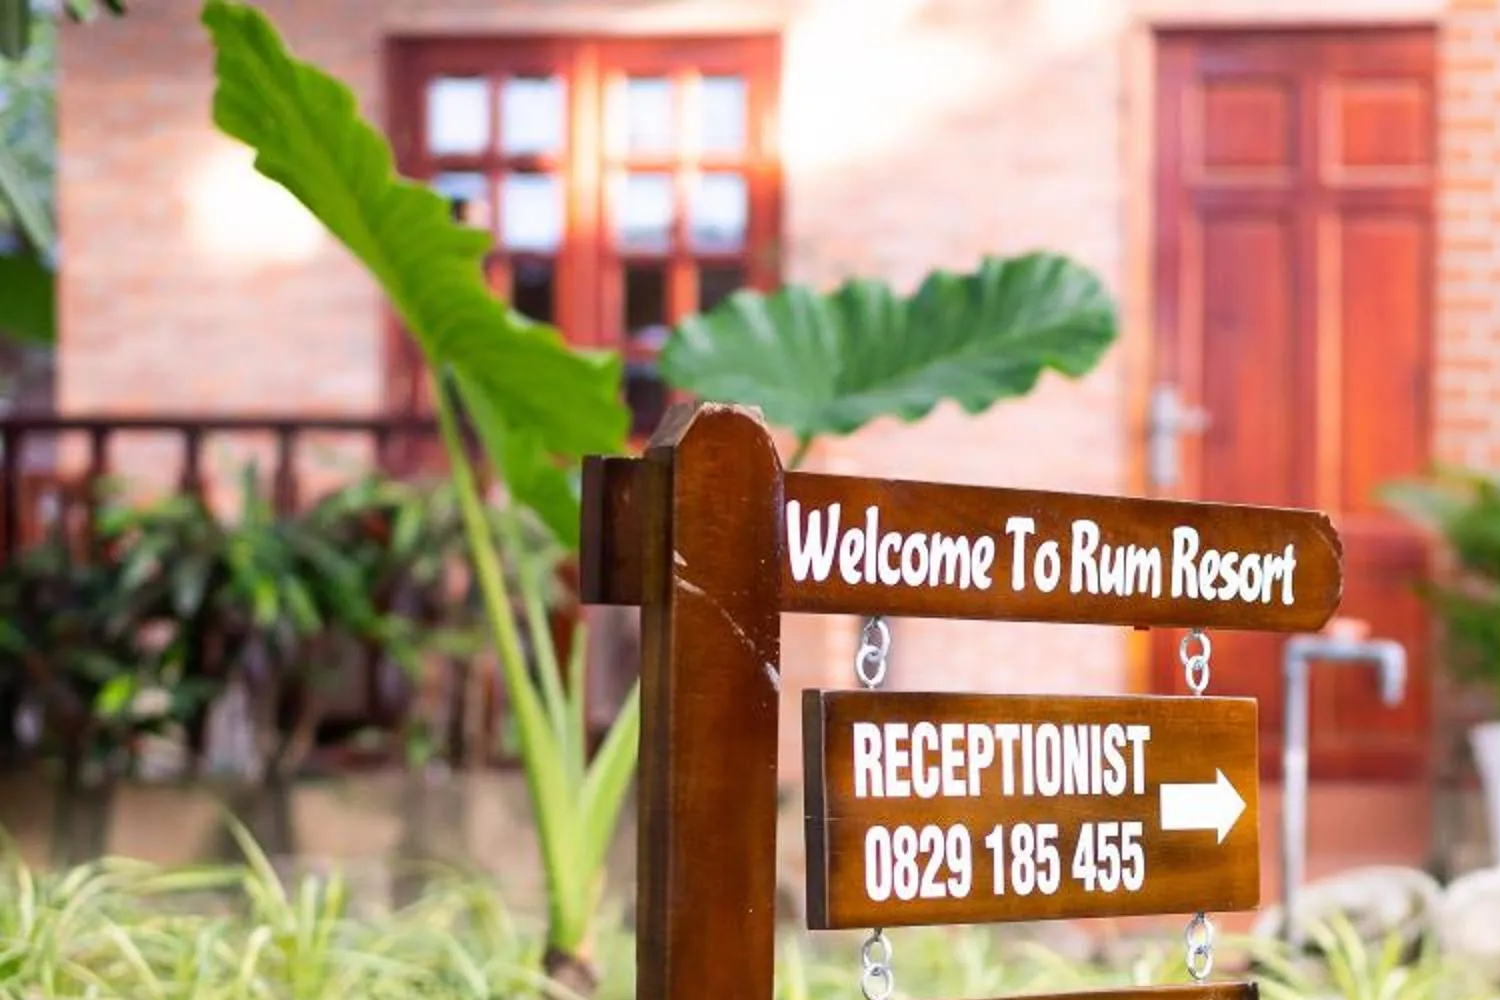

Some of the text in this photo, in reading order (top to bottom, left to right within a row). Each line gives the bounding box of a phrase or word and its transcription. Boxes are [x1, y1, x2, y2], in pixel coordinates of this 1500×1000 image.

[785, 499, 1297, 606] Welcome To Rum Resort
[852, 721, 1151, 799] RECEPTIONIST
[864, 820, 1146, 902] 0829 185 455
